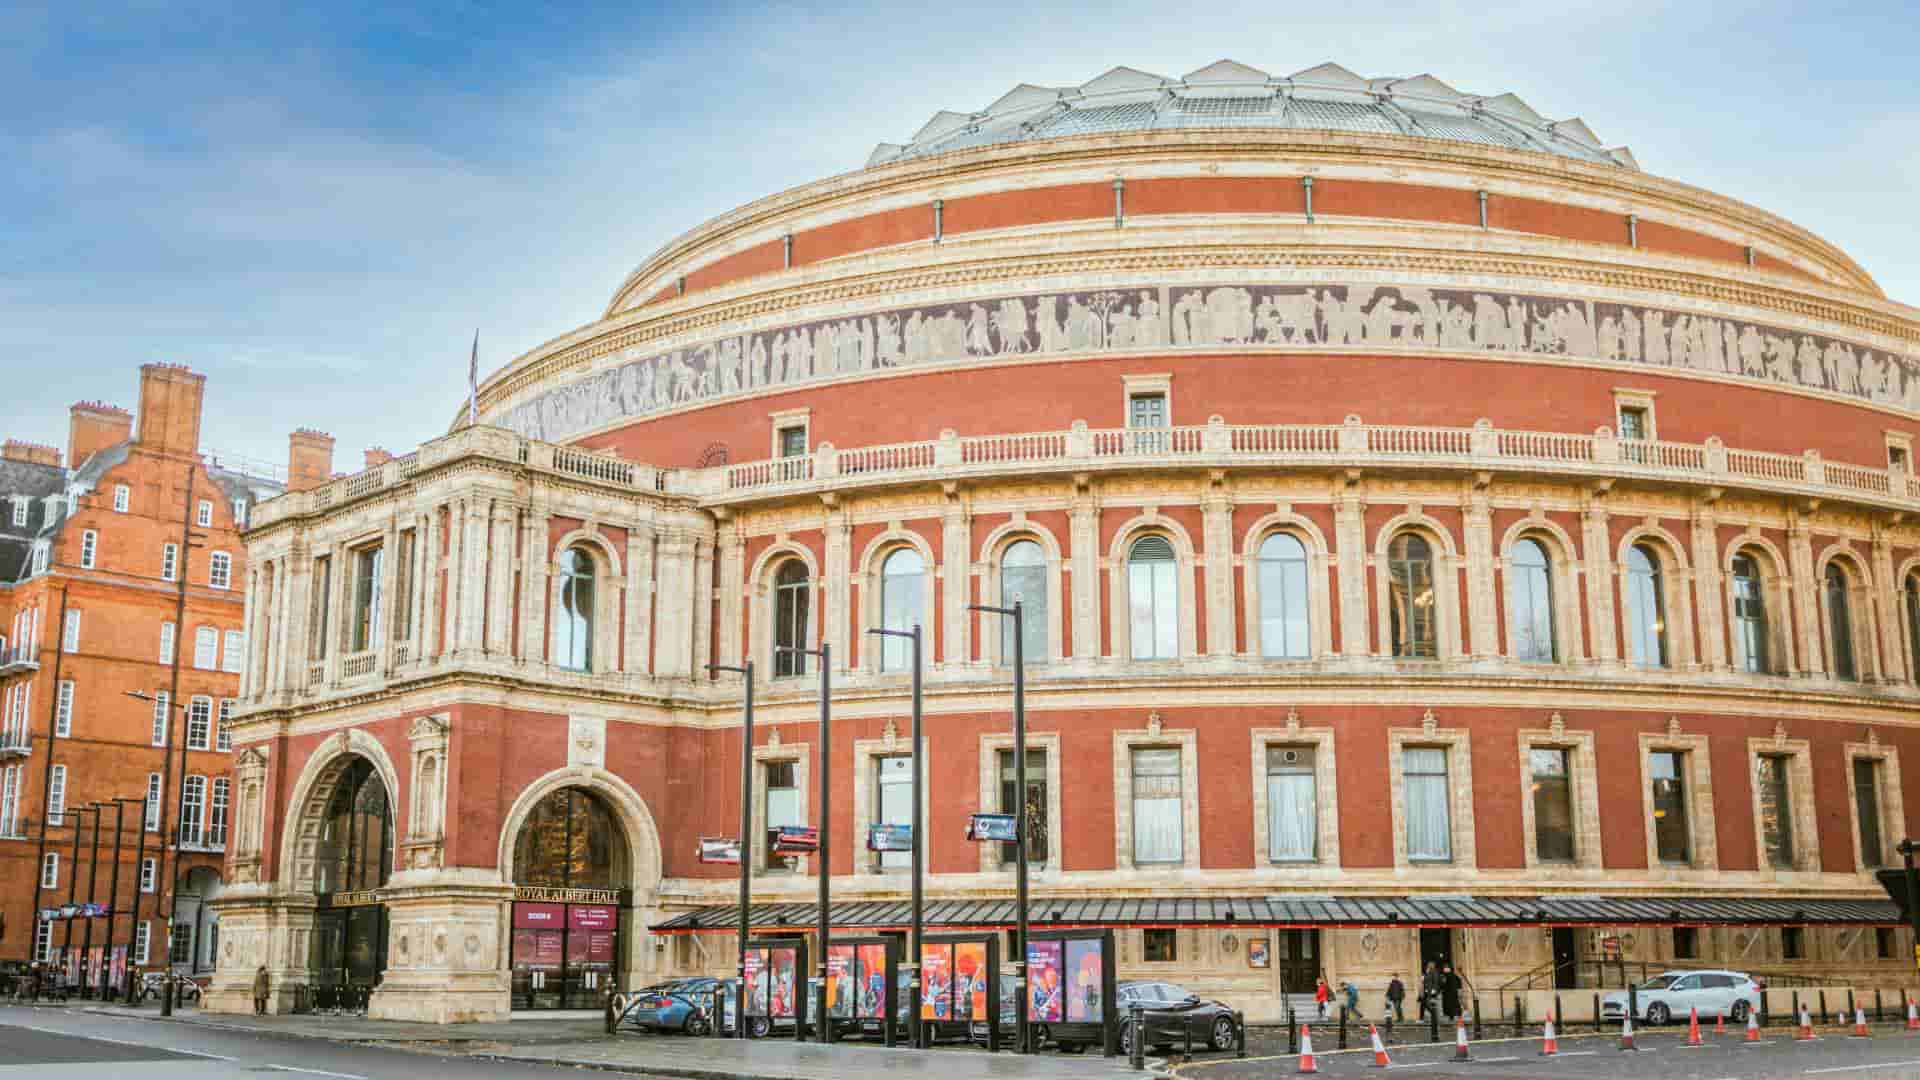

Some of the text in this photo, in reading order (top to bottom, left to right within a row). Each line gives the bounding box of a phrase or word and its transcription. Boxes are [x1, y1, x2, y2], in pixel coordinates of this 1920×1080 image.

[513, 887, 620, 904] ROYAL ALBERT HALL
